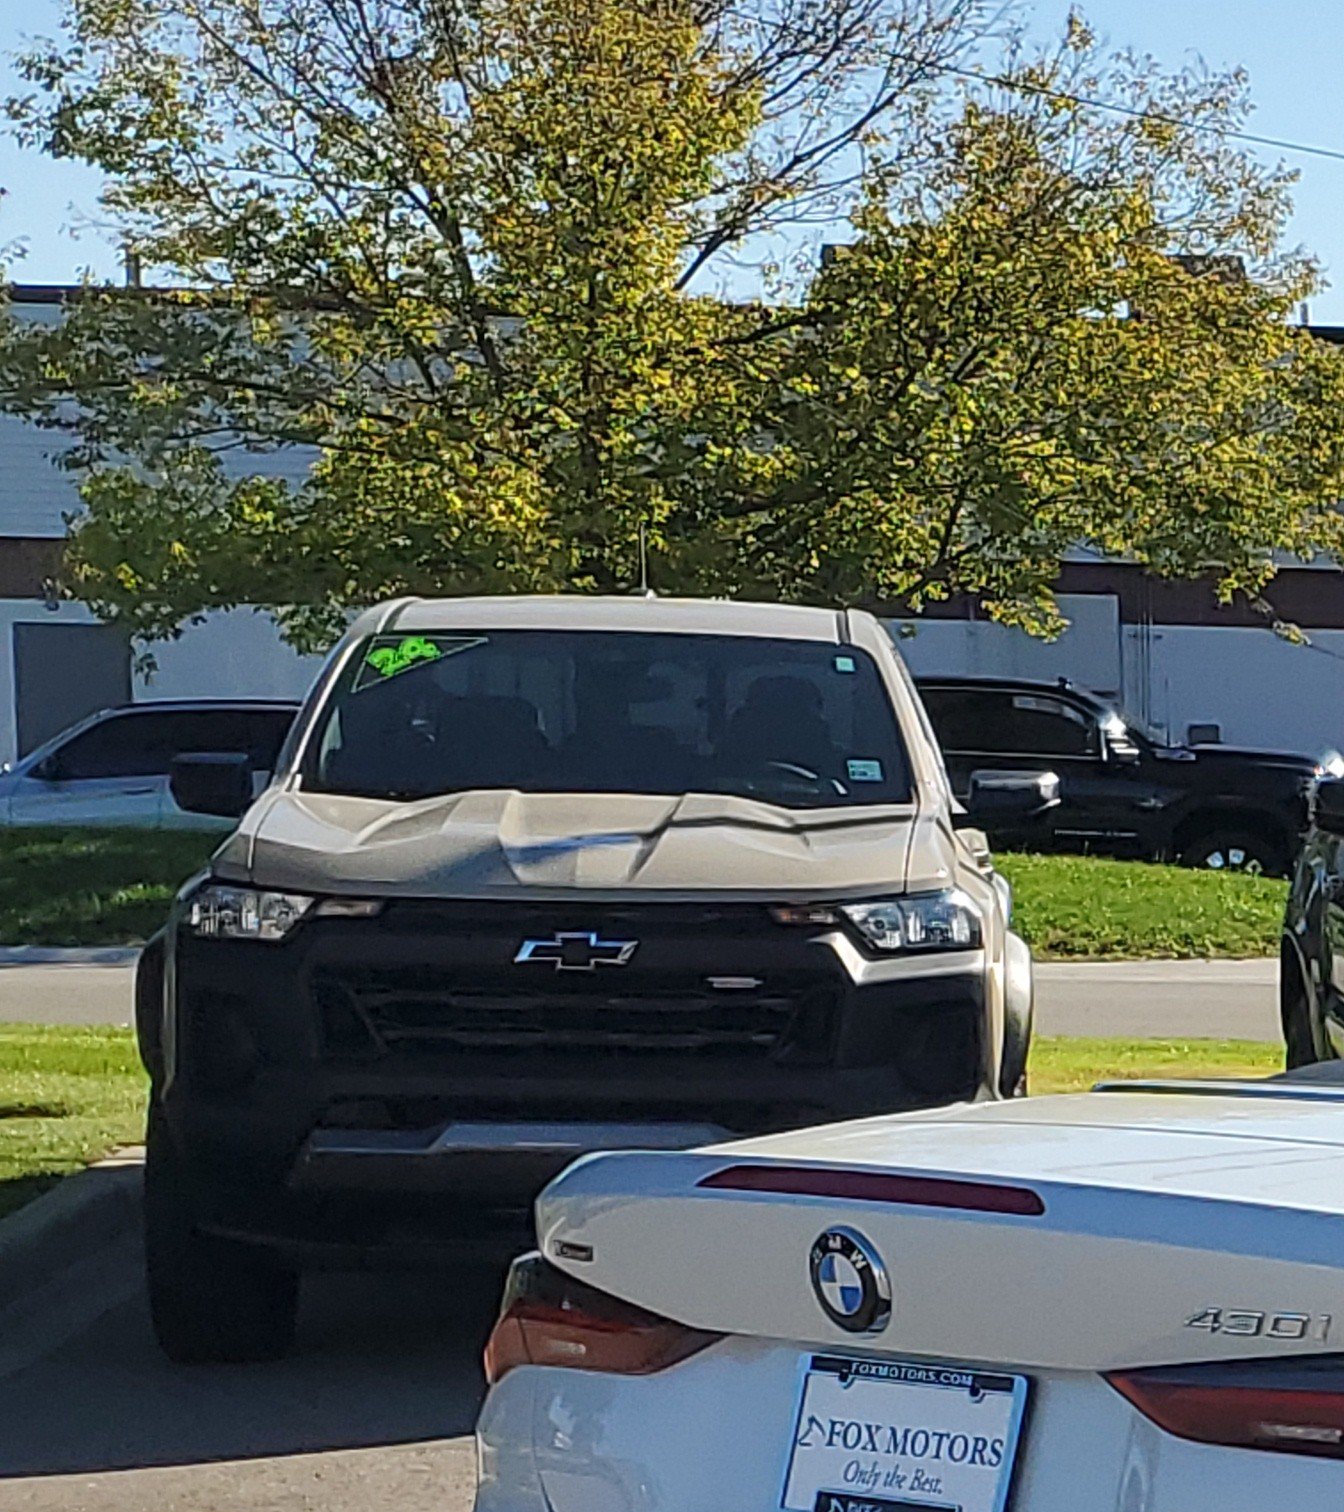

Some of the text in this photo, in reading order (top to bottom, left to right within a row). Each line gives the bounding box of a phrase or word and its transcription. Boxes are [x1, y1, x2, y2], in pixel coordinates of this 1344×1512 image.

[1183, 1306, 1333, 1345] 430i
[850, 1362, 974, 1387] FOXMOTORS.COM
[825, 1418, 1004, 1468] FOX MOTORS
[843, 1460, 944, 1495] Only the Best.
